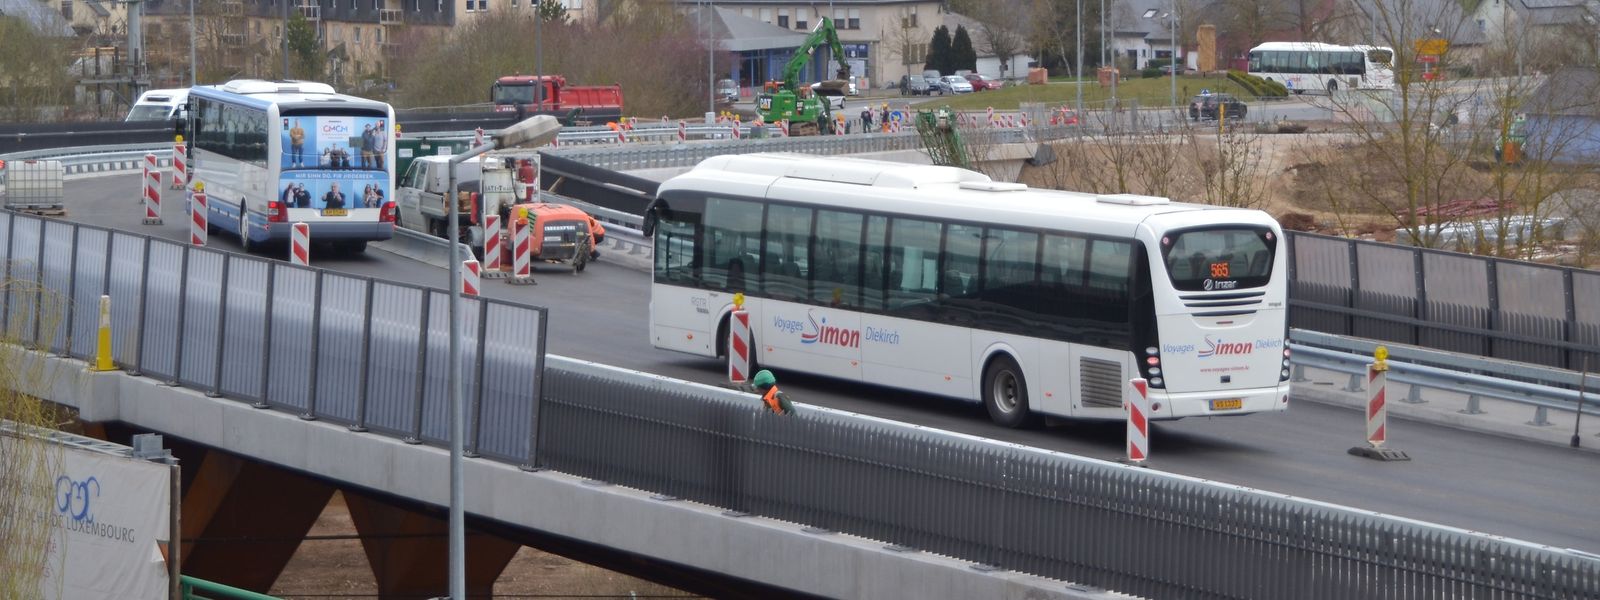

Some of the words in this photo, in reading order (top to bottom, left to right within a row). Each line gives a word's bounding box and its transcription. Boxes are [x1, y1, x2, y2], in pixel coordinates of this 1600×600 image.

[760, 98, 772, 110] CAT
[1210, 262, 1229, 277] 565
[773, 315, 804, 333] Voyages
[801, 308, 860, 348] Simon
[865, 326, 900, 345] Diekirch
[1163, 343, 1194, 355] Voyages
[1197, 334, 1252, 357] Simon
[1255, 338, 1282, 349] Diekirch
[67, 516, 135, 543] LUXEMBOURG
